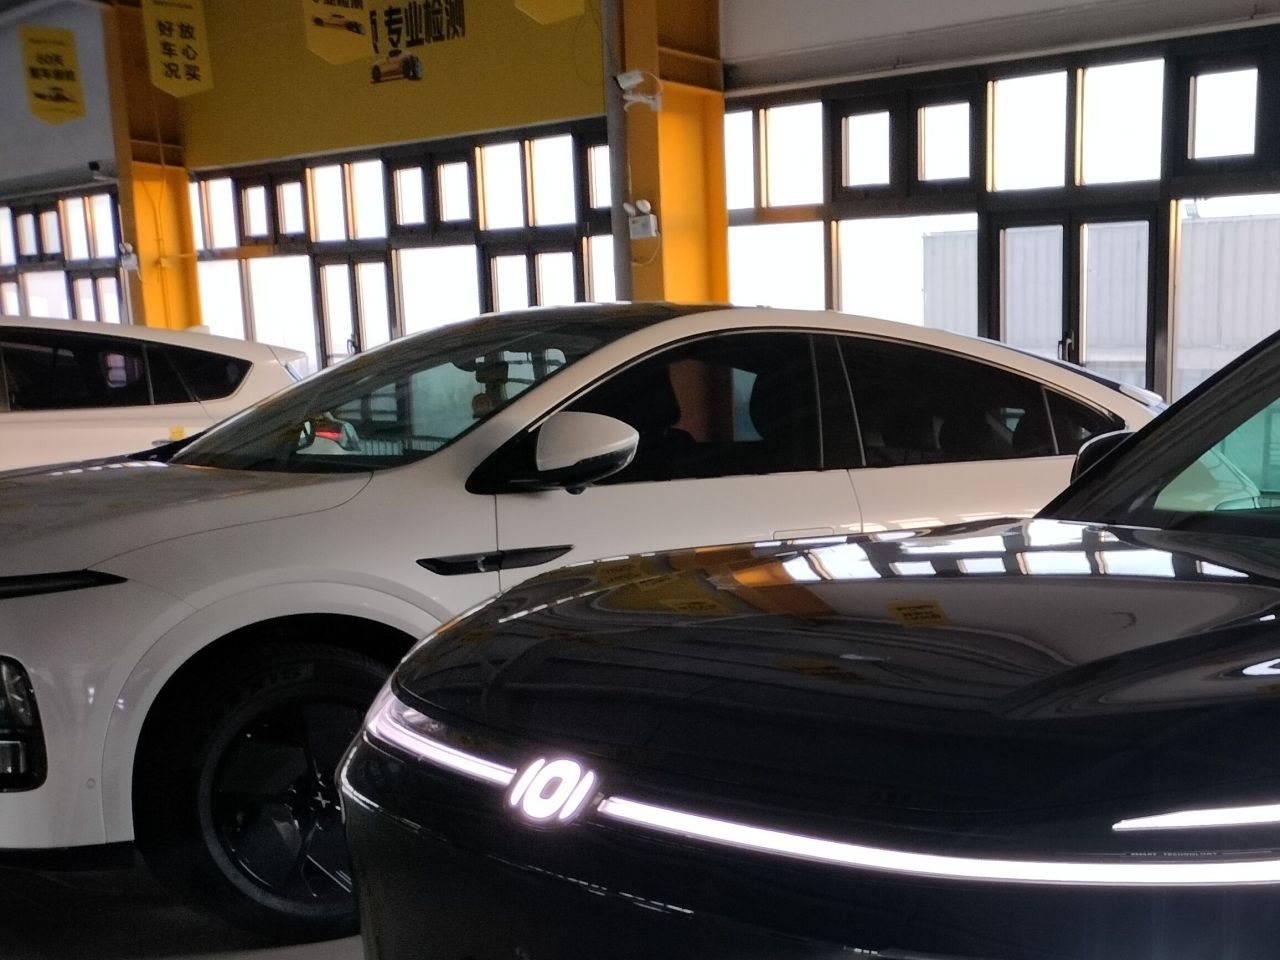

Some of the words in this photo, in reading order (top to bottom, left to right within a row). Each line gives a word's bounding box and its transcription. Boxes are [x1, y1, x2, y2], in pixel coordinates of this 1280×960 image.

[157, 20, 181, 79] 好车况
[178, 22, 202, 82] 放心买
[369, 0, 466, 54] 专业检测
